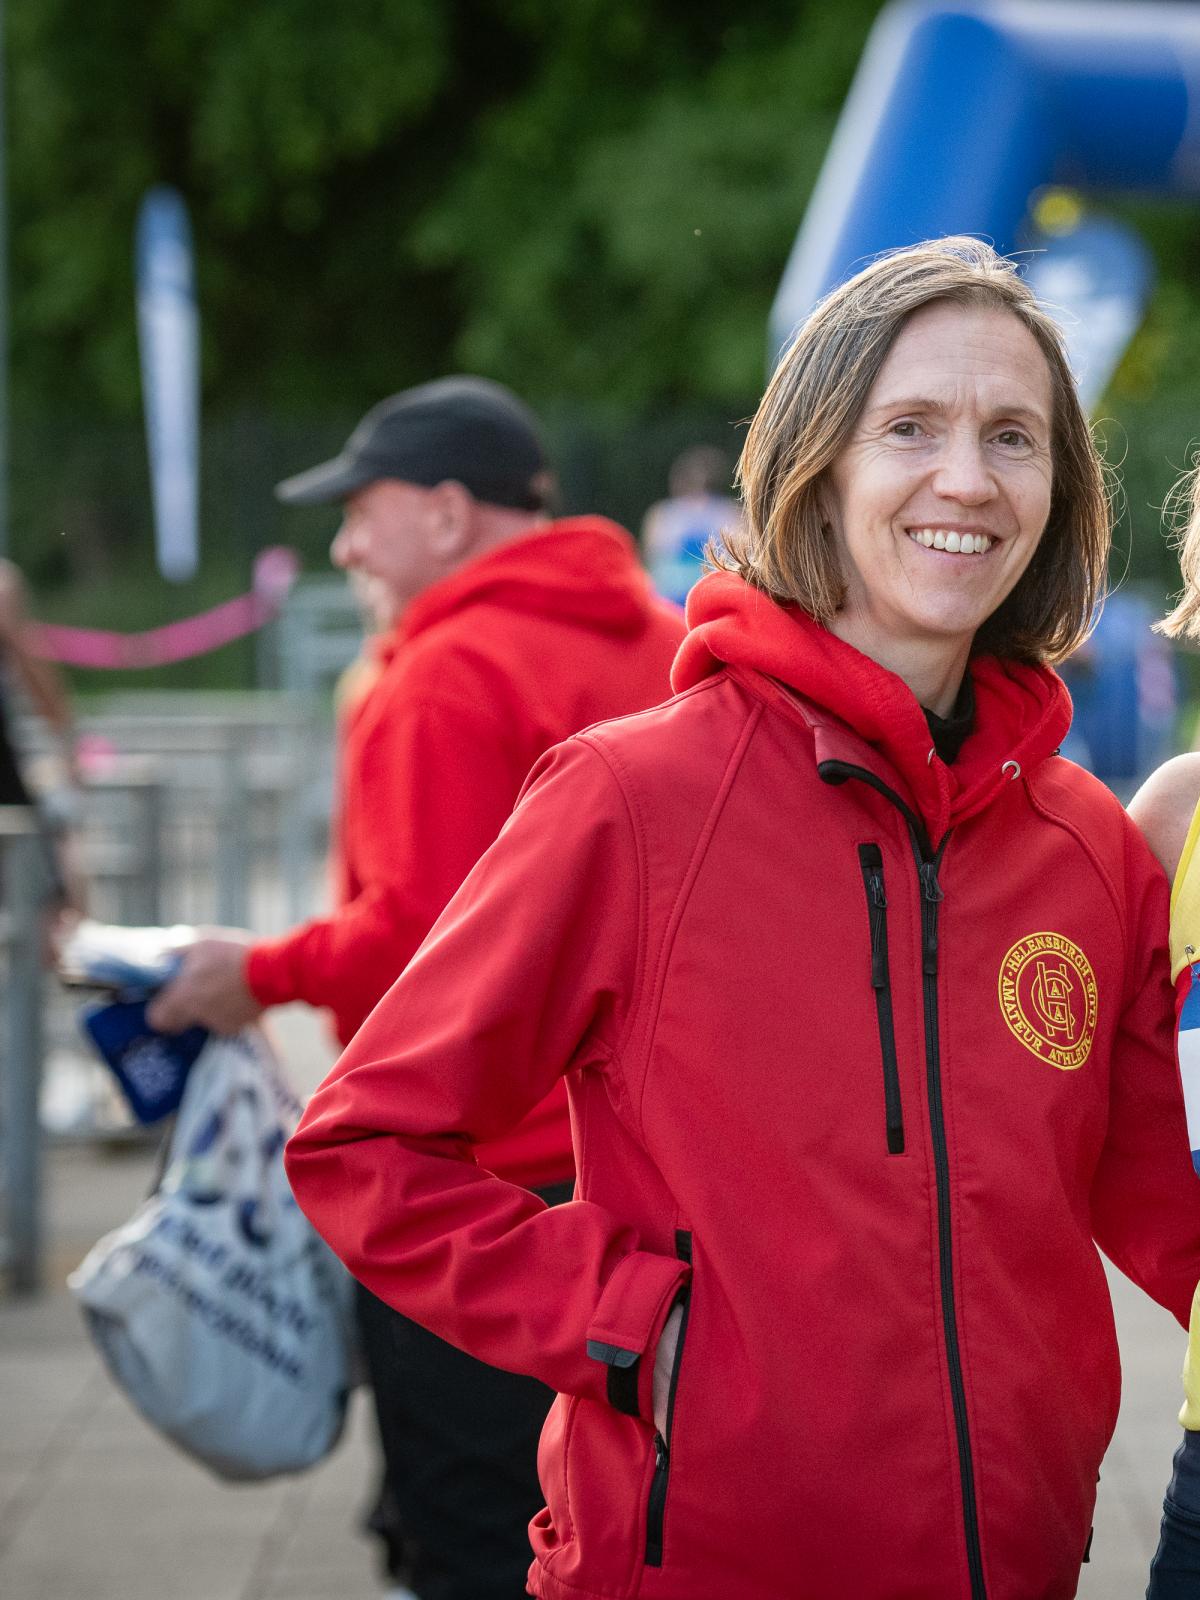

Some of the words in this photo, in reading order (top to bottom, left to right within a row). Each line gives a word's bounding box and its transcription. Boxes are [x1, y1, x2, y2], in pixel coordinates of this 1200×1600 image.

[1006, 936, 1091, 977] HELENSBURGH
[1002, 975, 1043, 1052] AMATEUR
[1048, 1030, 1093, 1066] ATHLETIC
